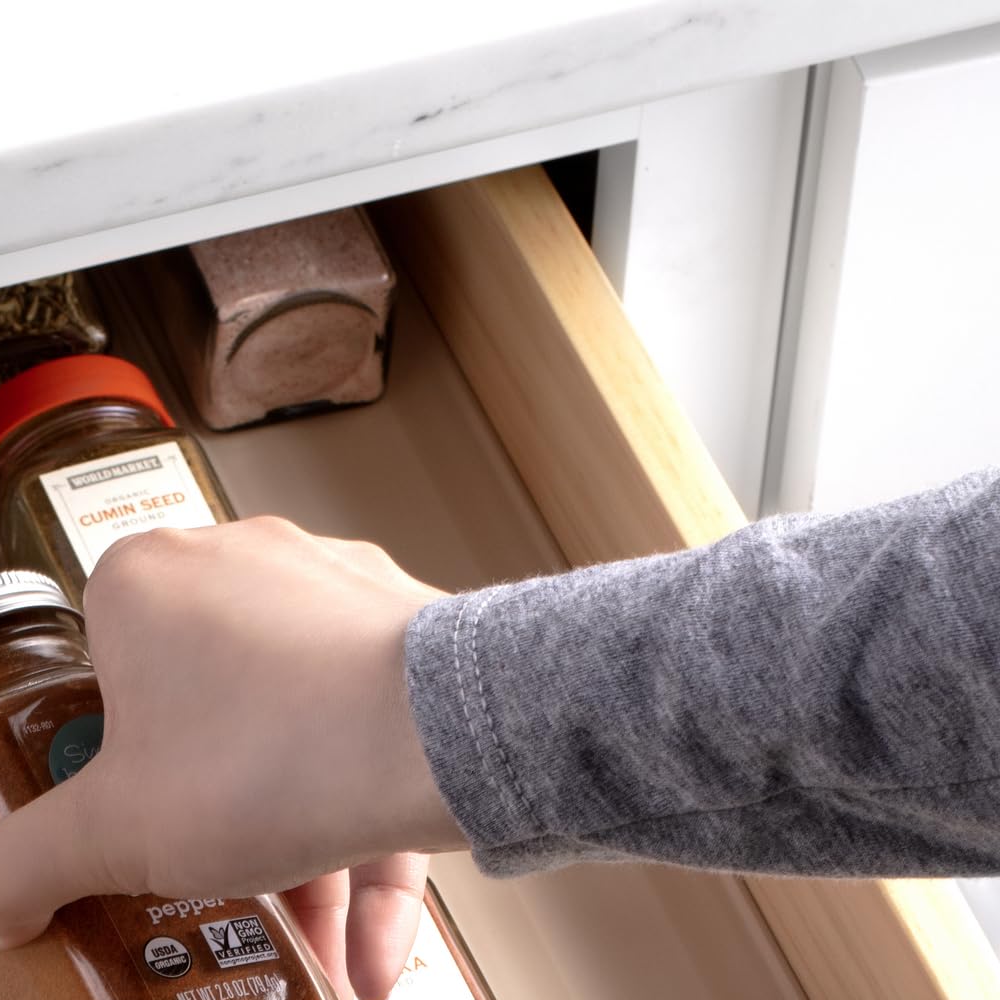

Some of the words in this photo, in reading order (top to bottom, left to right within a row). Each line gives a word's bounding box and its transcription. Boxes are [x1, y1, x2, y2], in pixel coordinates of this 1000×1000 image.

[104, 489, 150, 504] ORGANIC
[79, 503, 136, 527] CUMIN
[140, 492, 185, 510] SEED
[112, 511, 165, 530] GROUND
[146, 898, 225, 924] pepper
[234, 917, 259, 930] NON
[238, 927, 263, 940] GMO
[241, 935, 267, 945] Project
[151, 944, 178, 958] USDA
[218, 943, 272, 959] VERIFIED
[154, 956, 187, 970] ORGANIC
[215, 983, 234, 1000] 2.8
[232, 979, 250, 997] OZ
